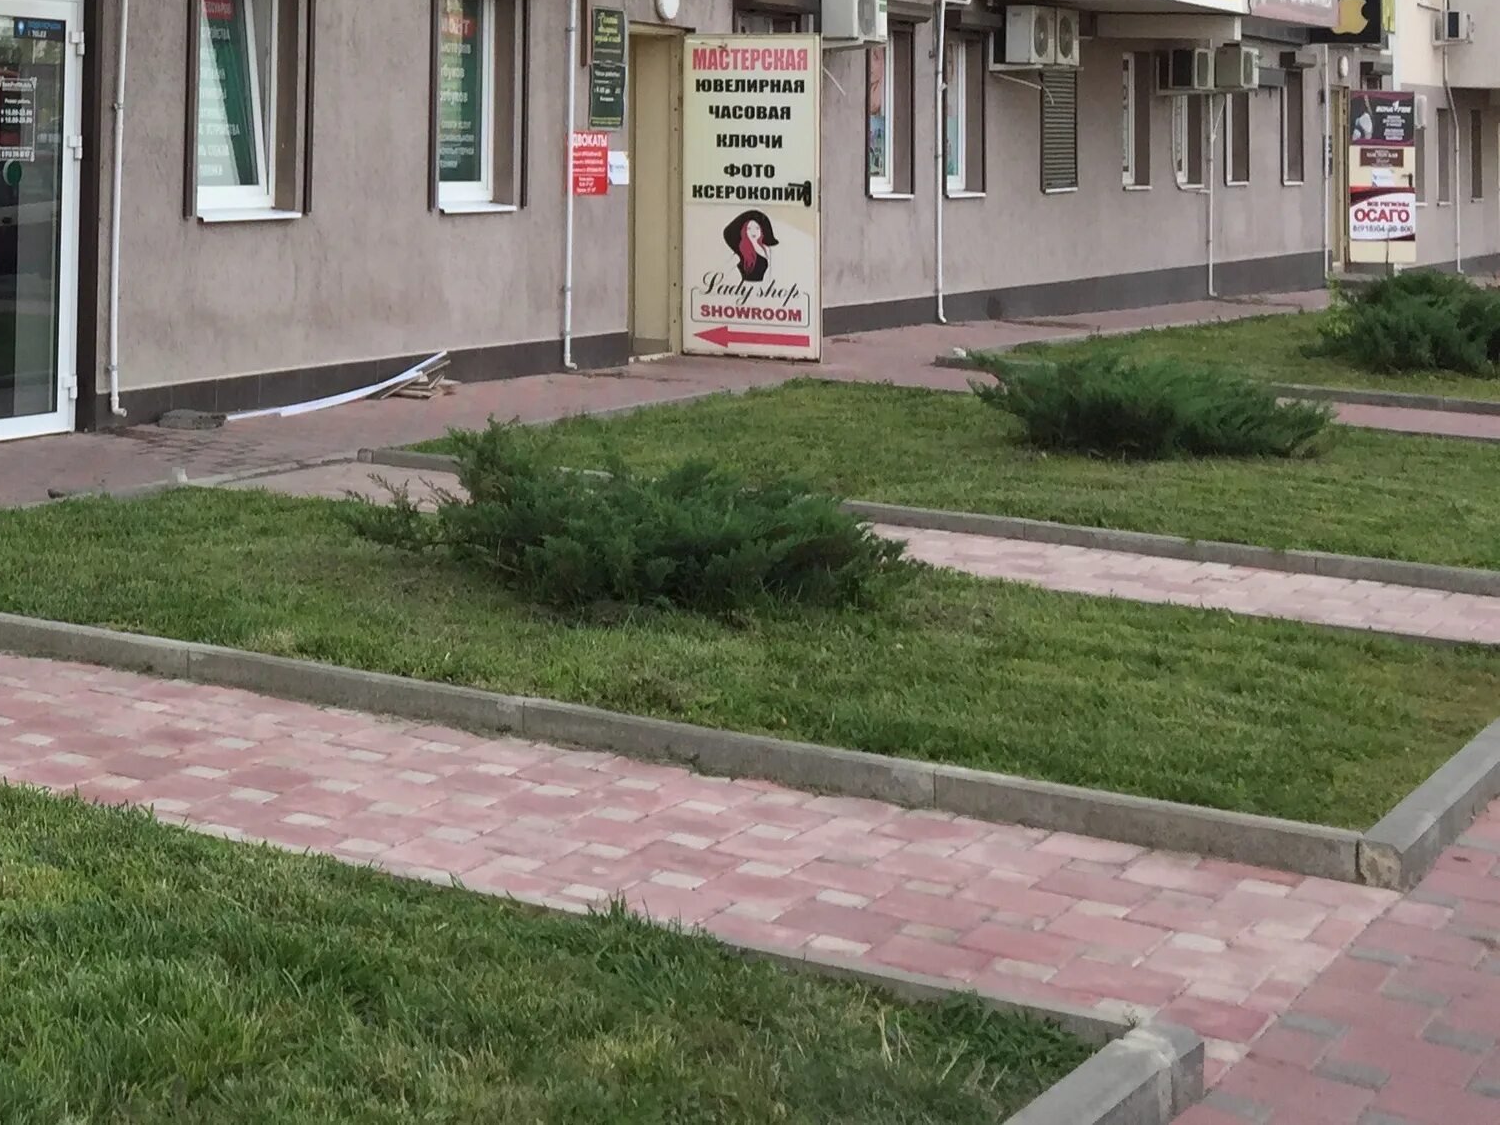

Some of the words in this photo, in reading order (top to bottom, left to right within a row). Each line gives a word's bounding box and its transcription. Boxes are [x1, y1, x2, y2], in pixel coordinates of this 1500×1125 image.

[692, 47, 808, 72] МАСТЕРСКАЯ
[695, 78, 806, 95] ЮВЕЛИРНАЯ
[708, 105, 792, 121] ЧАСОВАЯ
[716, 133, 783, 150] КЛЮЧИ
[723, 163, 775, 179] ФОТО
[1353, 207, 1411, 224] ОСАГО
[701, 271, 754, 306] Lady
[755, 279, 801, 308] shop
[700, 304, 803, 322] SHOWROOM
